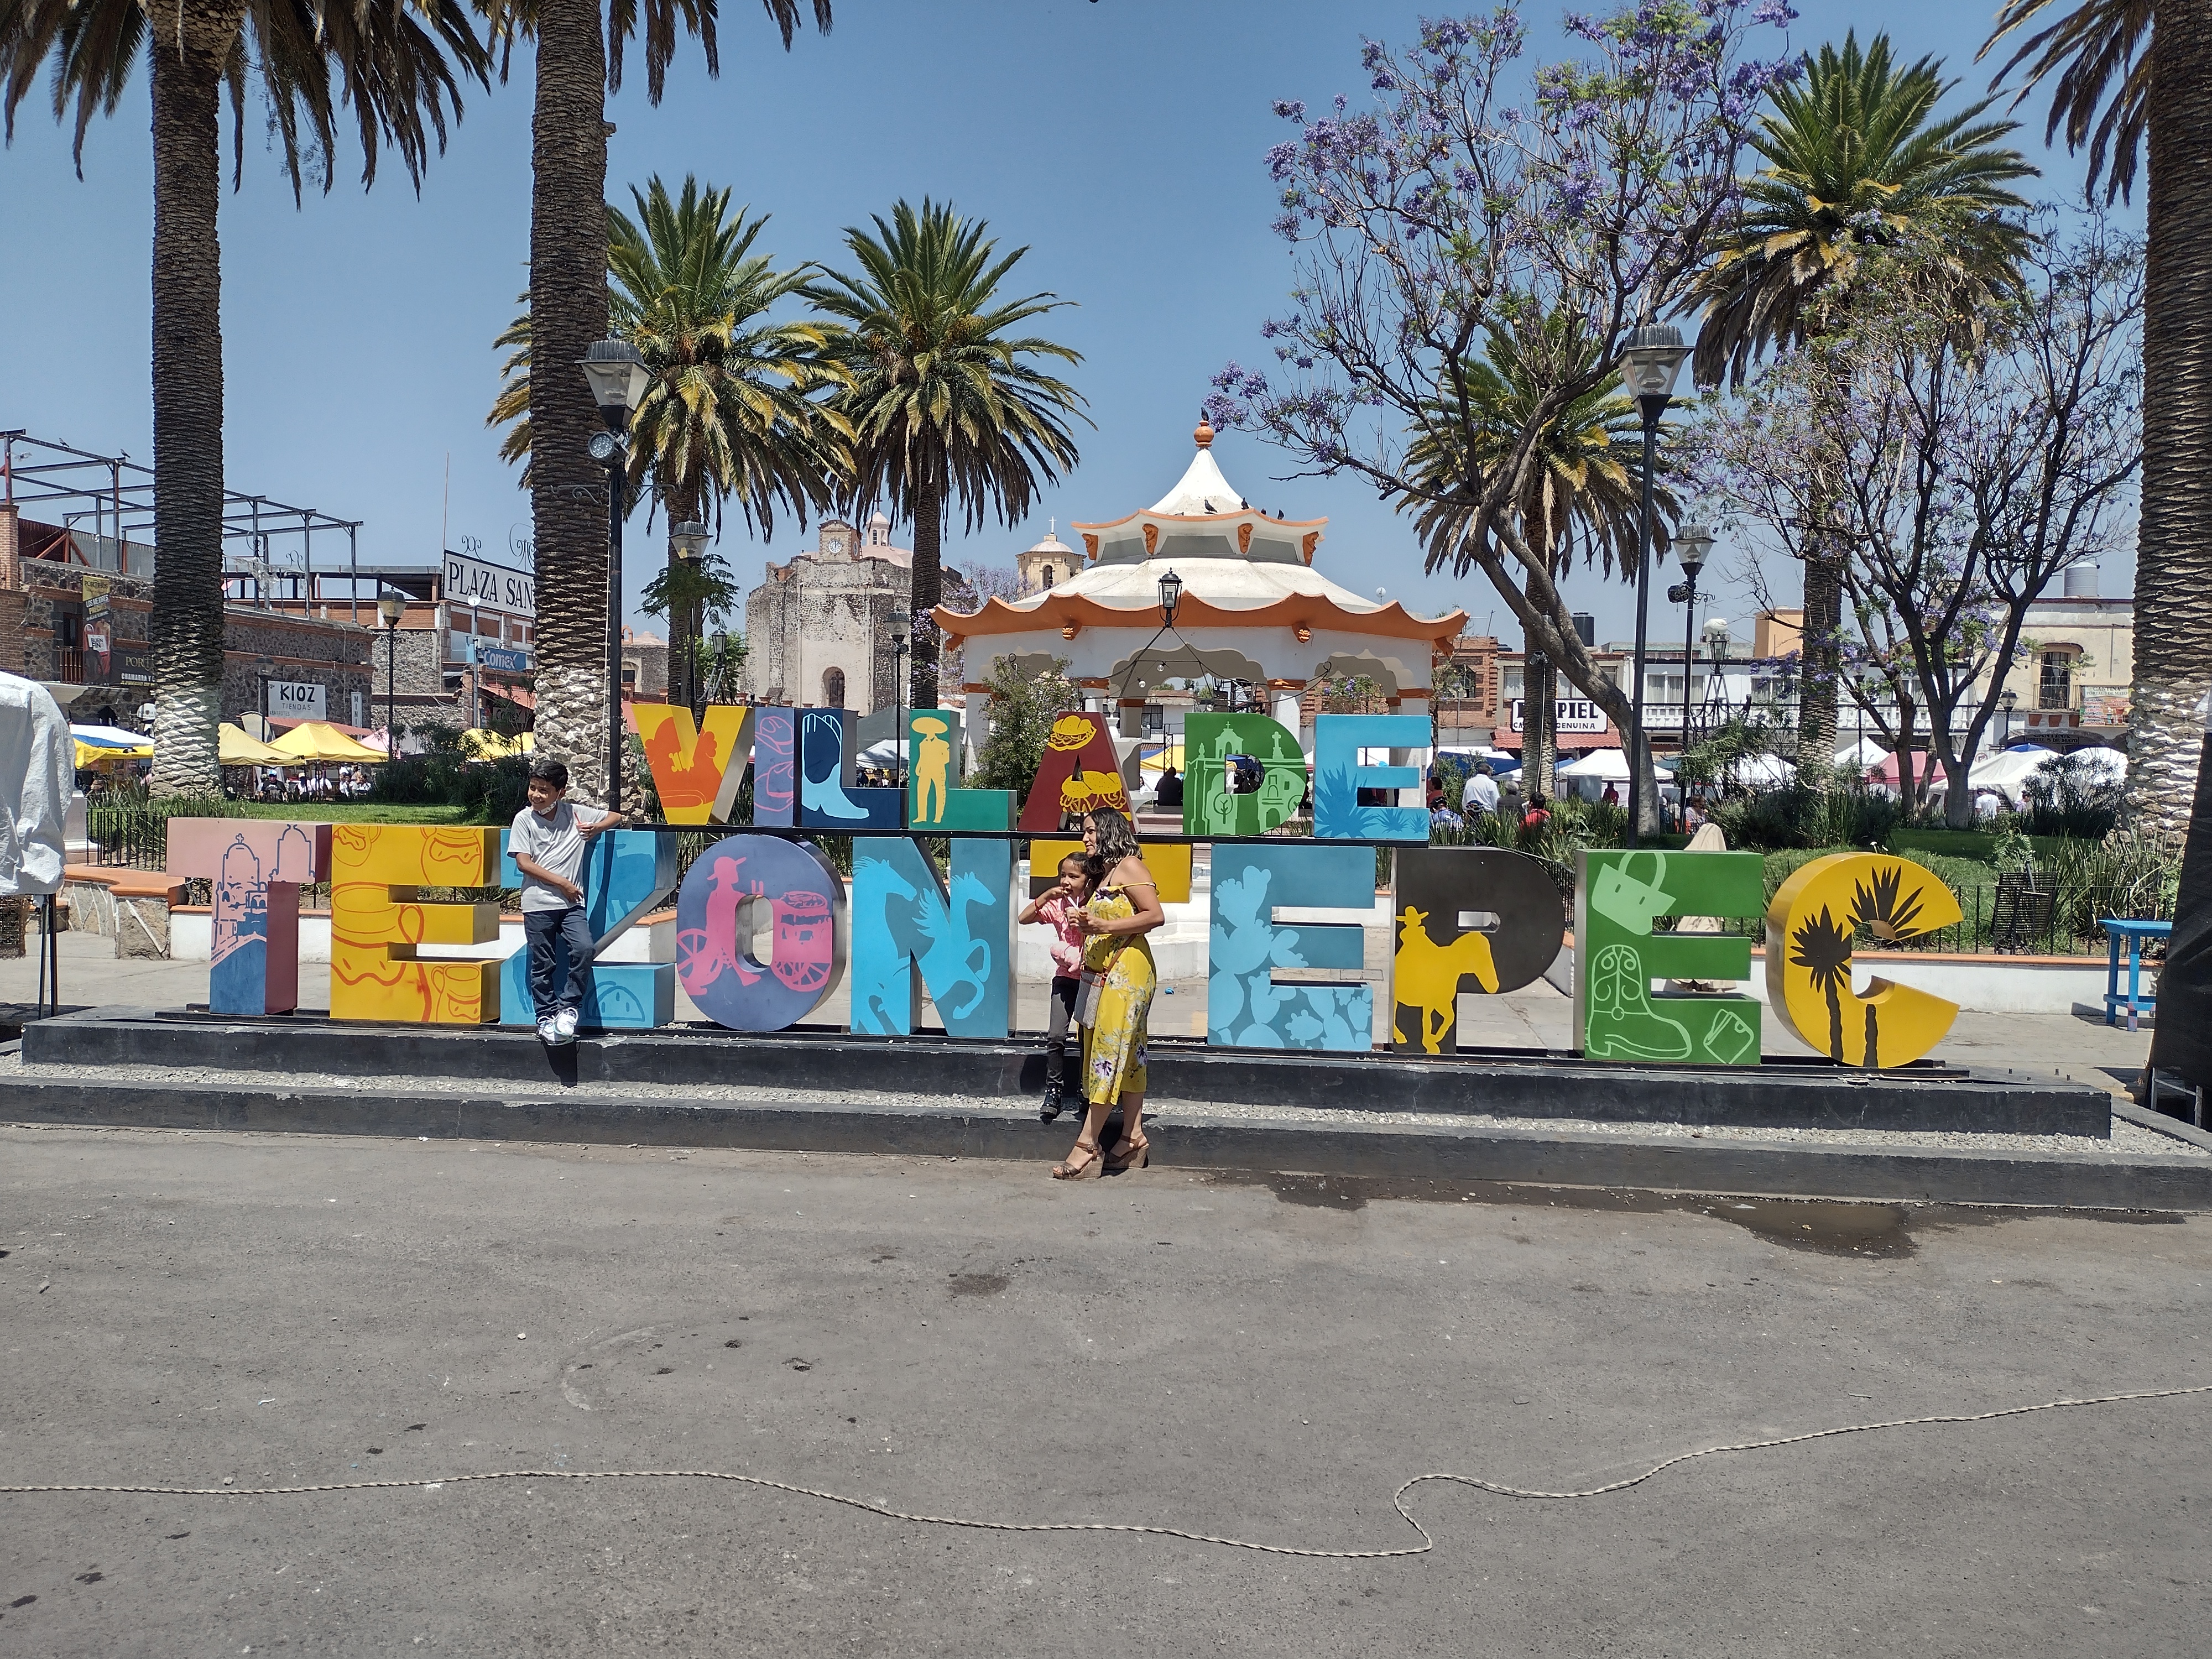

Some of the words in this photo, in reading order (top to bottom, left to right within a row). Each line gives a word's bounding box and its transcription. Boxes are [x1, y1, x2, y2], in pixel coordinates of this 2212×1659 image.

[448, 561, 499, 603] PLAZA
[505, 577, 533, 611] SAN
[126, 655, 153, 671] PORT
[484, 649, 518, 670] Comex
[121, 672, 148, 681] CHAMARRA
[1557, 702, 1599, 718] PIEL
[632, 703, 1140, 832] VILLA
[1183, 713, 1431, 839] DE
